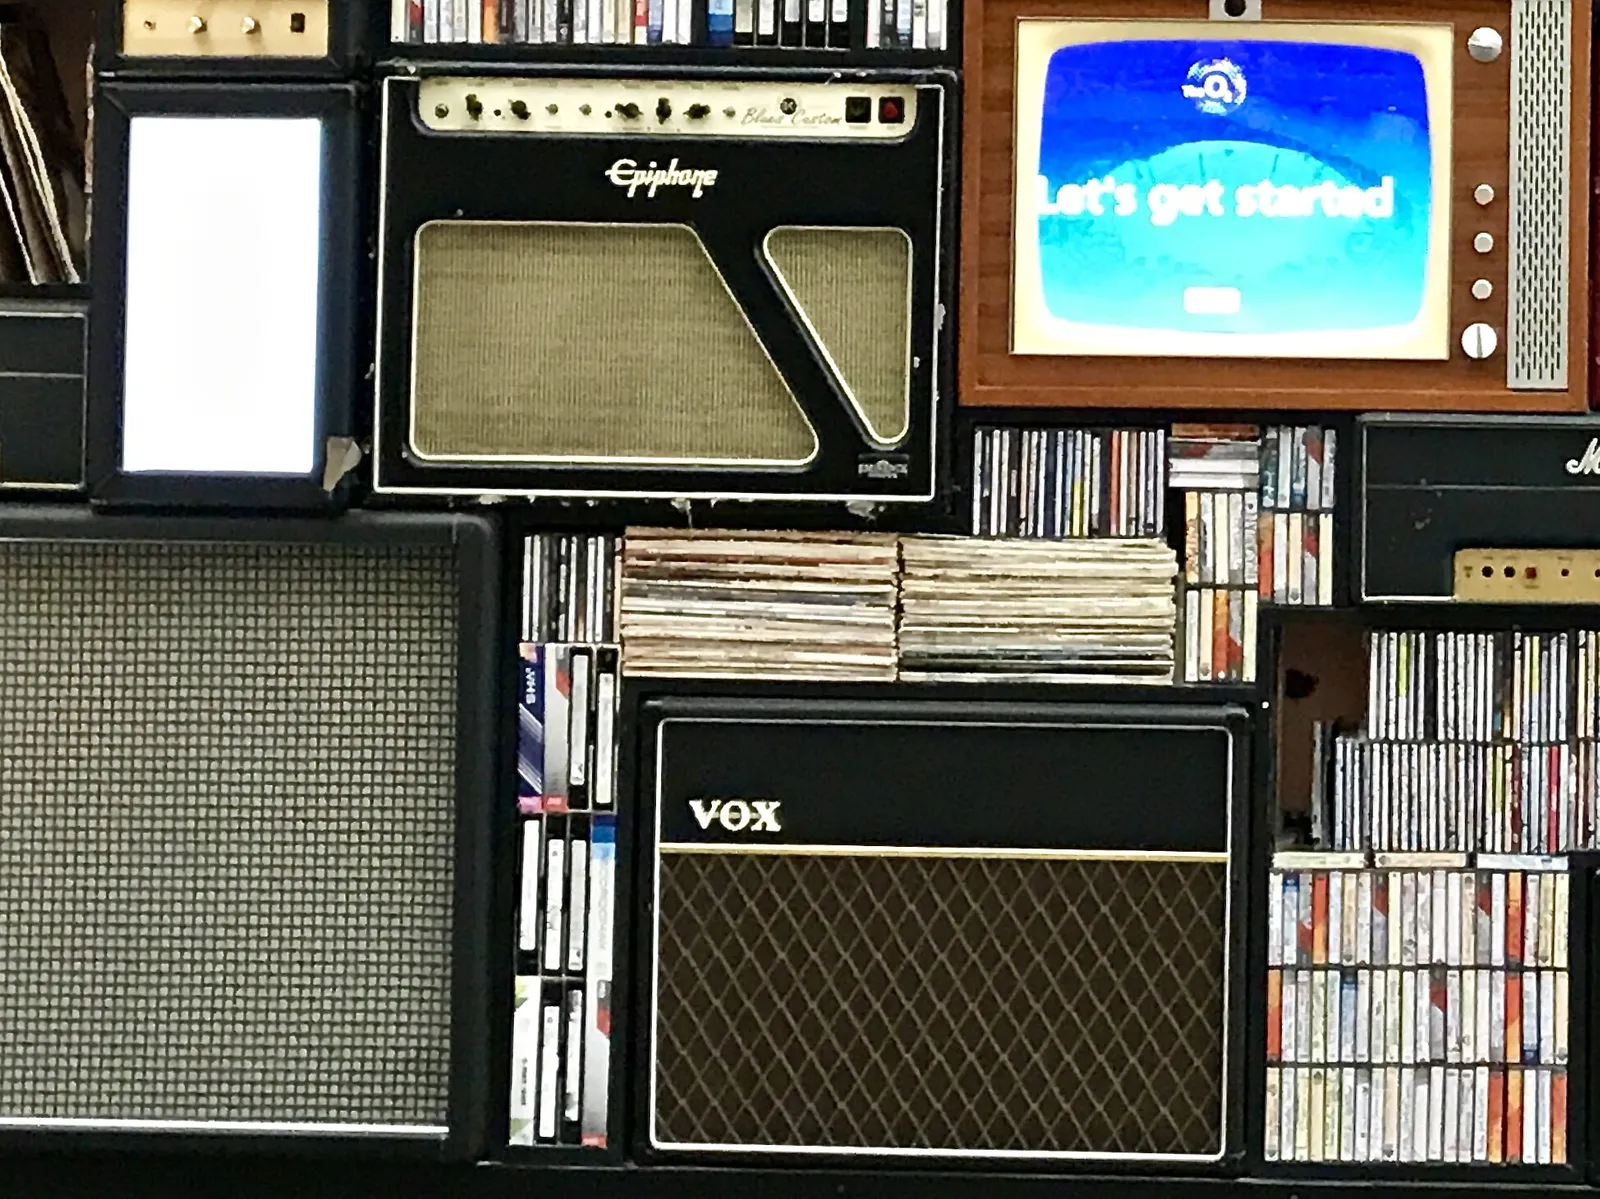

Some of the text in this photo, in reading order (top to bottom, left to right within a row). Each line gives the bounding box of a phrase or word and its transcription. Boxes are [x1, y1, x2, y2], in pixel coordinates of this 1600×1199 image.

[604, 158, 719, 198] Epiphone
[1036, 174, 1394, 227] Let's get started
[688, 798, 782, 833] VOX
